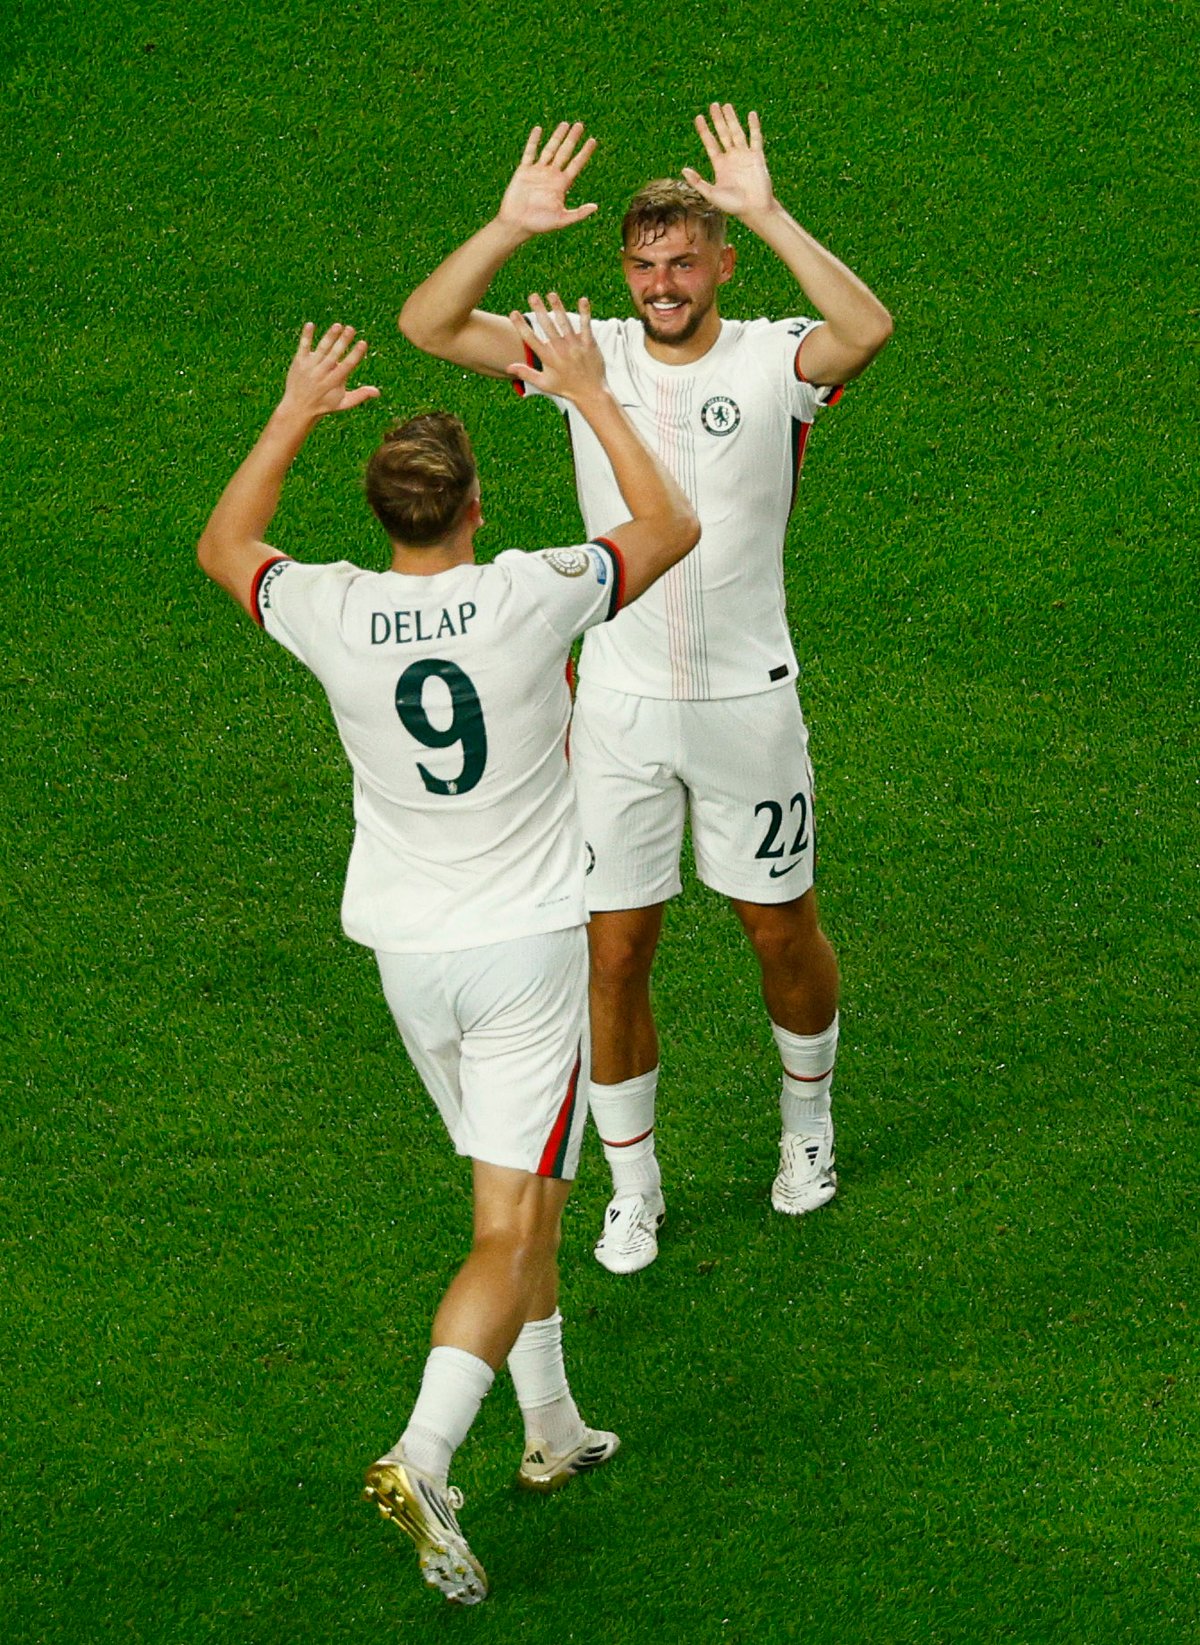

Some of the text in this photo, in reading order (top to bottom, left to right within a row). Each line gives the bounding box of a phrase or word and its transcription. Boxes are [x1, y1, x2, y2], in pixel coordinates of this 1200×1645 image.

[371, 601, 477, 645] DELAP
[394, 658, 488, 796] 9
[754, 791, 809, 859] 22
